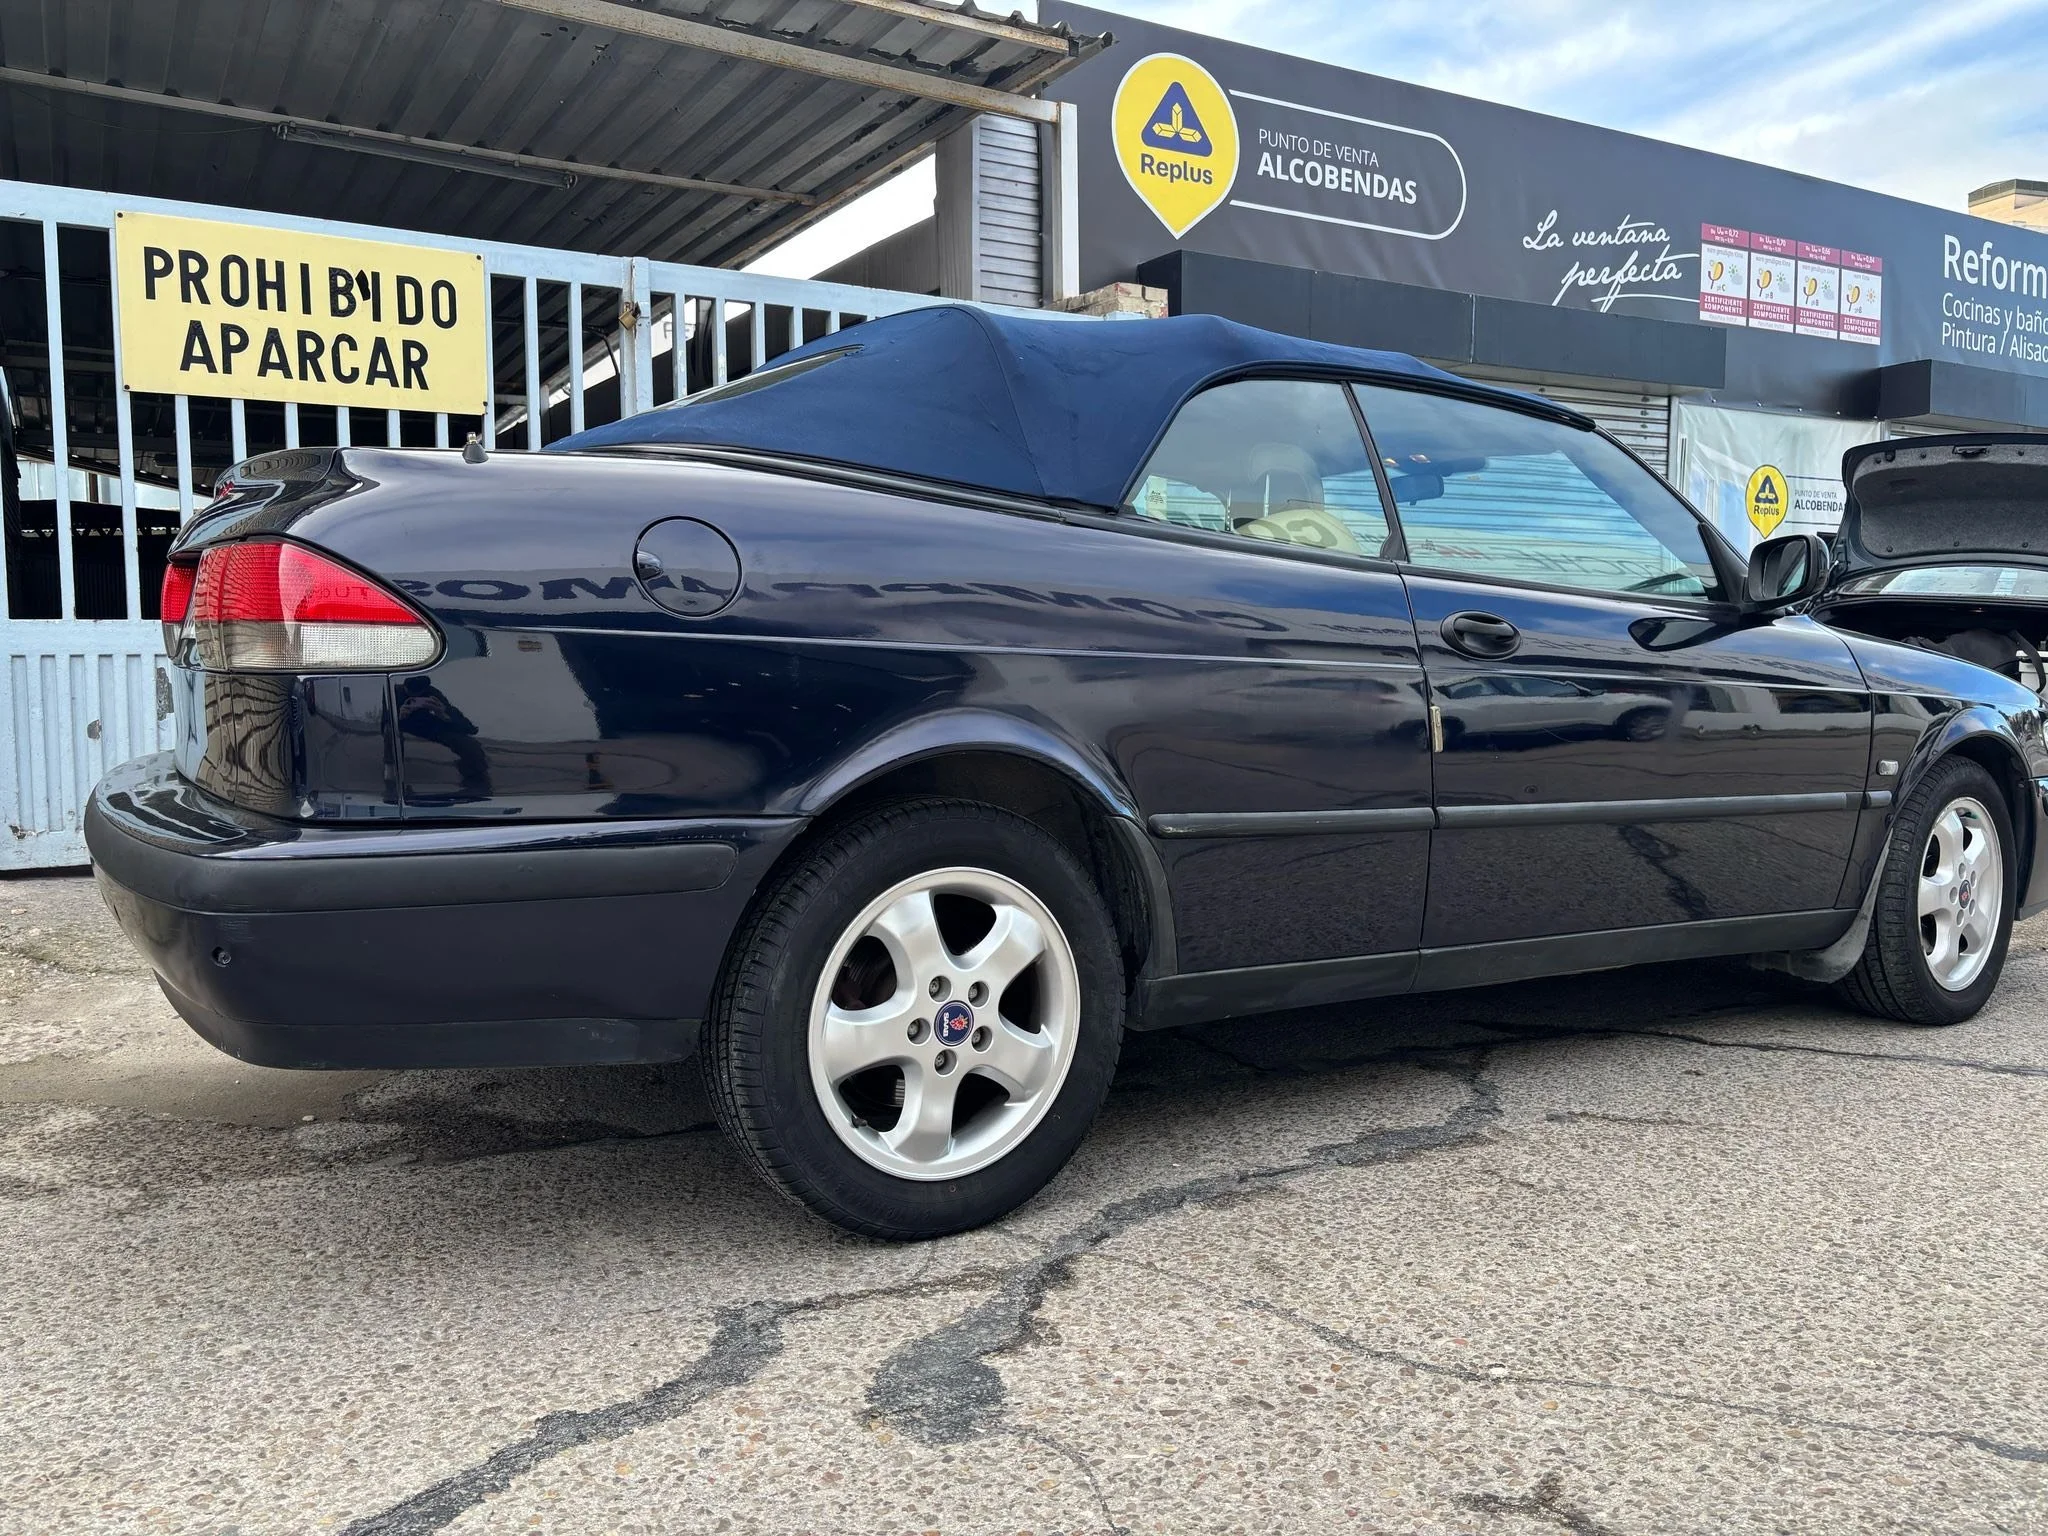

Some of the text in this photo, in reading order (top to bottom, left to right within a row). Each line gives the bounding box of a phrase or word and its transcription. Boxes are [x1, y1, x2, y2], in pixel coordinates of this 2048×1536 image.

[1258, 128, 1379, 168] PUNTO DE VENTA
[1140, 153, 1213, 185] Replus
[1256, 151, 1417, 205] ALCOBENDAS
[1522, 209, 1671, 251] La ventana
[1552, 244, 1699, 313] perfecta
[1943, 233, 2047, 299] Reform
[143, 245, 458, 330] PROHIBIDO
[1704, 303, 1743, 315] KOMPONENTE
[1753, 310, 1790, 321] KOMPONENTE
[1942, 292, 2001, 326] Cocinas
[2004, 309, 2013, 334] y
[179, 319, 430, 391] APARCAR
[1942, 321, 1996, 354] Pintura
[2000, 331, 2007, 355] /
[1753, 505, 1780, 517] Replus
[1794, 489, 1838, 499] PUNTO DE VENTA
[1794, 499, 1843, 512] ALCOBENDA
